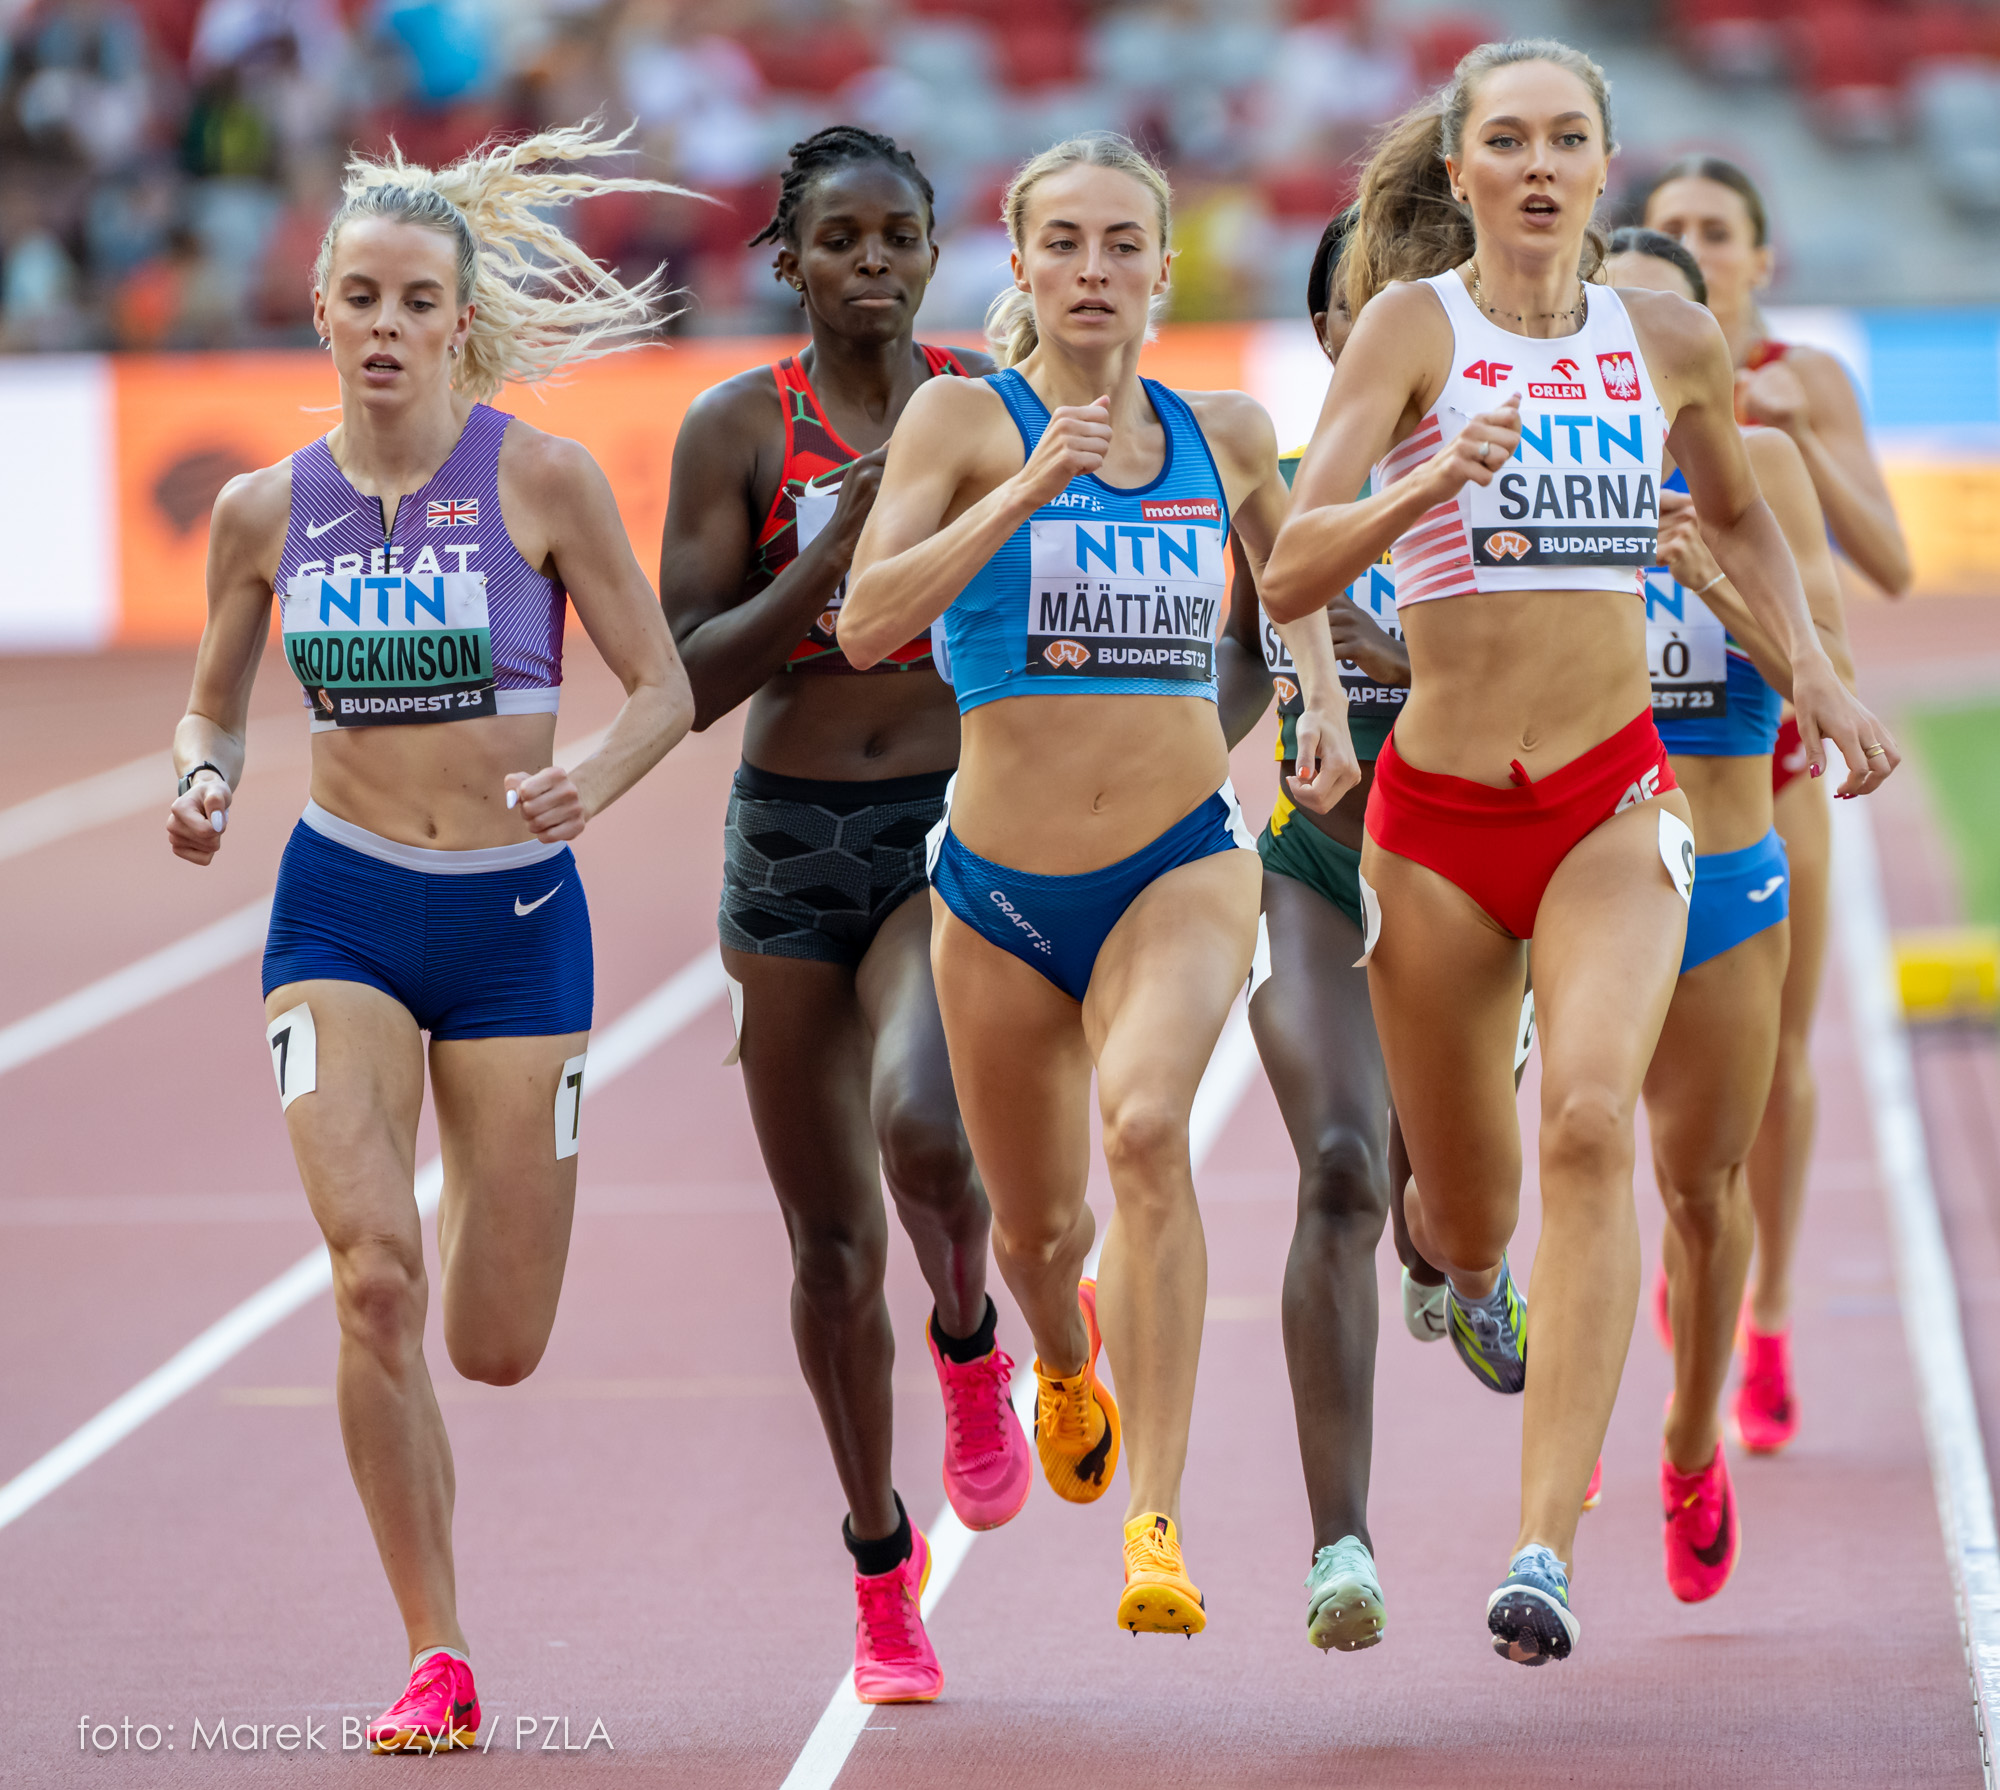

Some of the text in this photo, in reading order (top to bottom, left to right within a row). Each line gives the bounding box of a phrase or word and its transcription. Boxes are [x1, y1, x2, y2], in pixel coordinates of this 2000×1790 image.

[1463, 360, 1513, 387] 4F
[1531, 385, 1583, 398] ORLEN
[1145, 503, 1217, 518] motonet
[1499, 473, 1658, 520] SARNA
[1075, 523, 1199, 578] NTN
[1539, 537, 1650, 553] BUDAPEST
[319, 577, 446, 627] NTN
[1039, 583, 1215, 639] MÄÄTTÄNEN
[292, 634, 481, 682] HODGKINSON
[1098, 648, 1206, 668] BUDAPEST 23
[340, 691, 482, 714] BUDAPEST 23
[1689, 691, 1714, 707] 23
[1614, 764, 1659, 814] 4F
[989, 890, 1042, 940] CRAFT
[272, 1026, 292, 1097] 7
